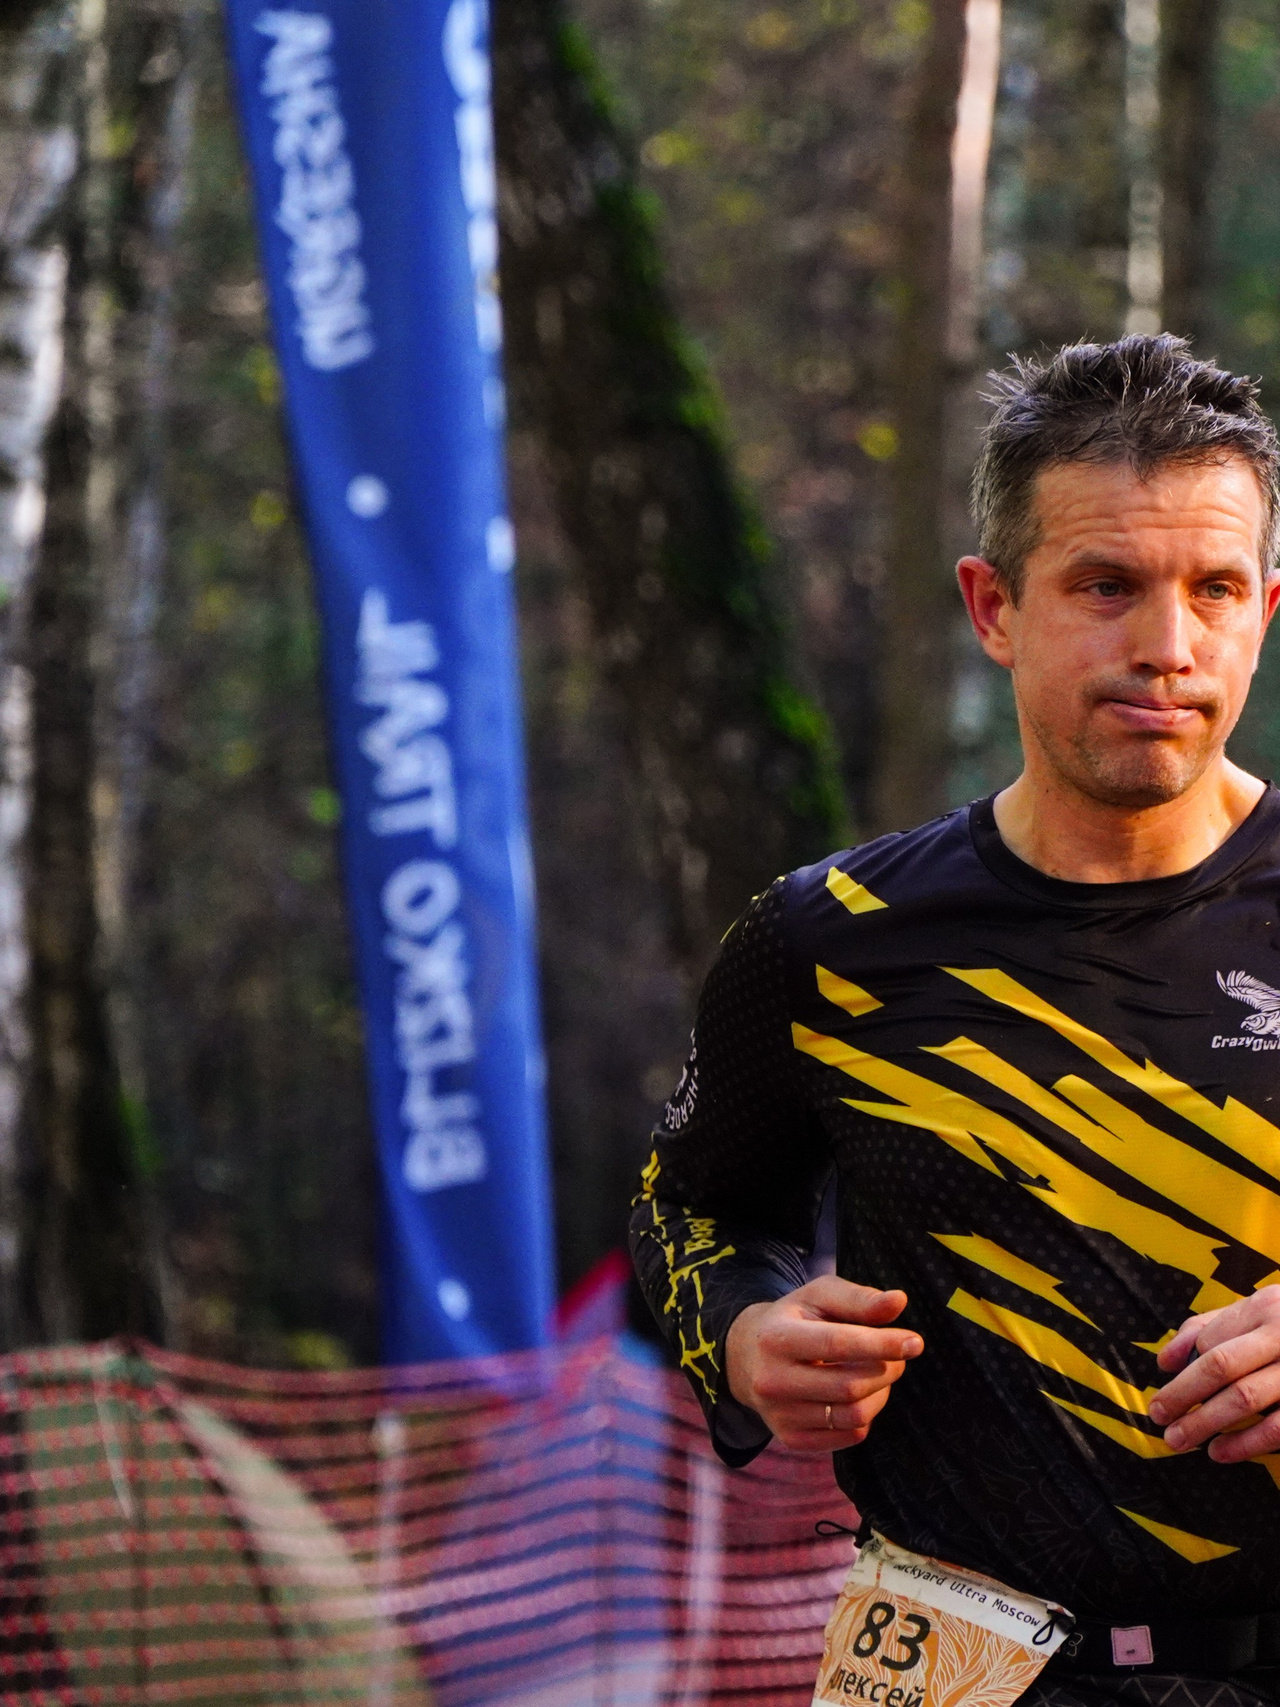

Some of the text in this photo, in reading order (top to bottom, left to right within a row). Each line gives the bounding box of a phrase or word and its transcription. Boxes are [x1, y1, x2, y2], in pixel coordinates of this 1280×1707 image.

[949, 1581, 987, 1604] Ultra
[991, 1598, 1041, 1627] Moscow
[853, 1602, 930, 1671] 83
[829, 1666, 925, 1707] лексей
